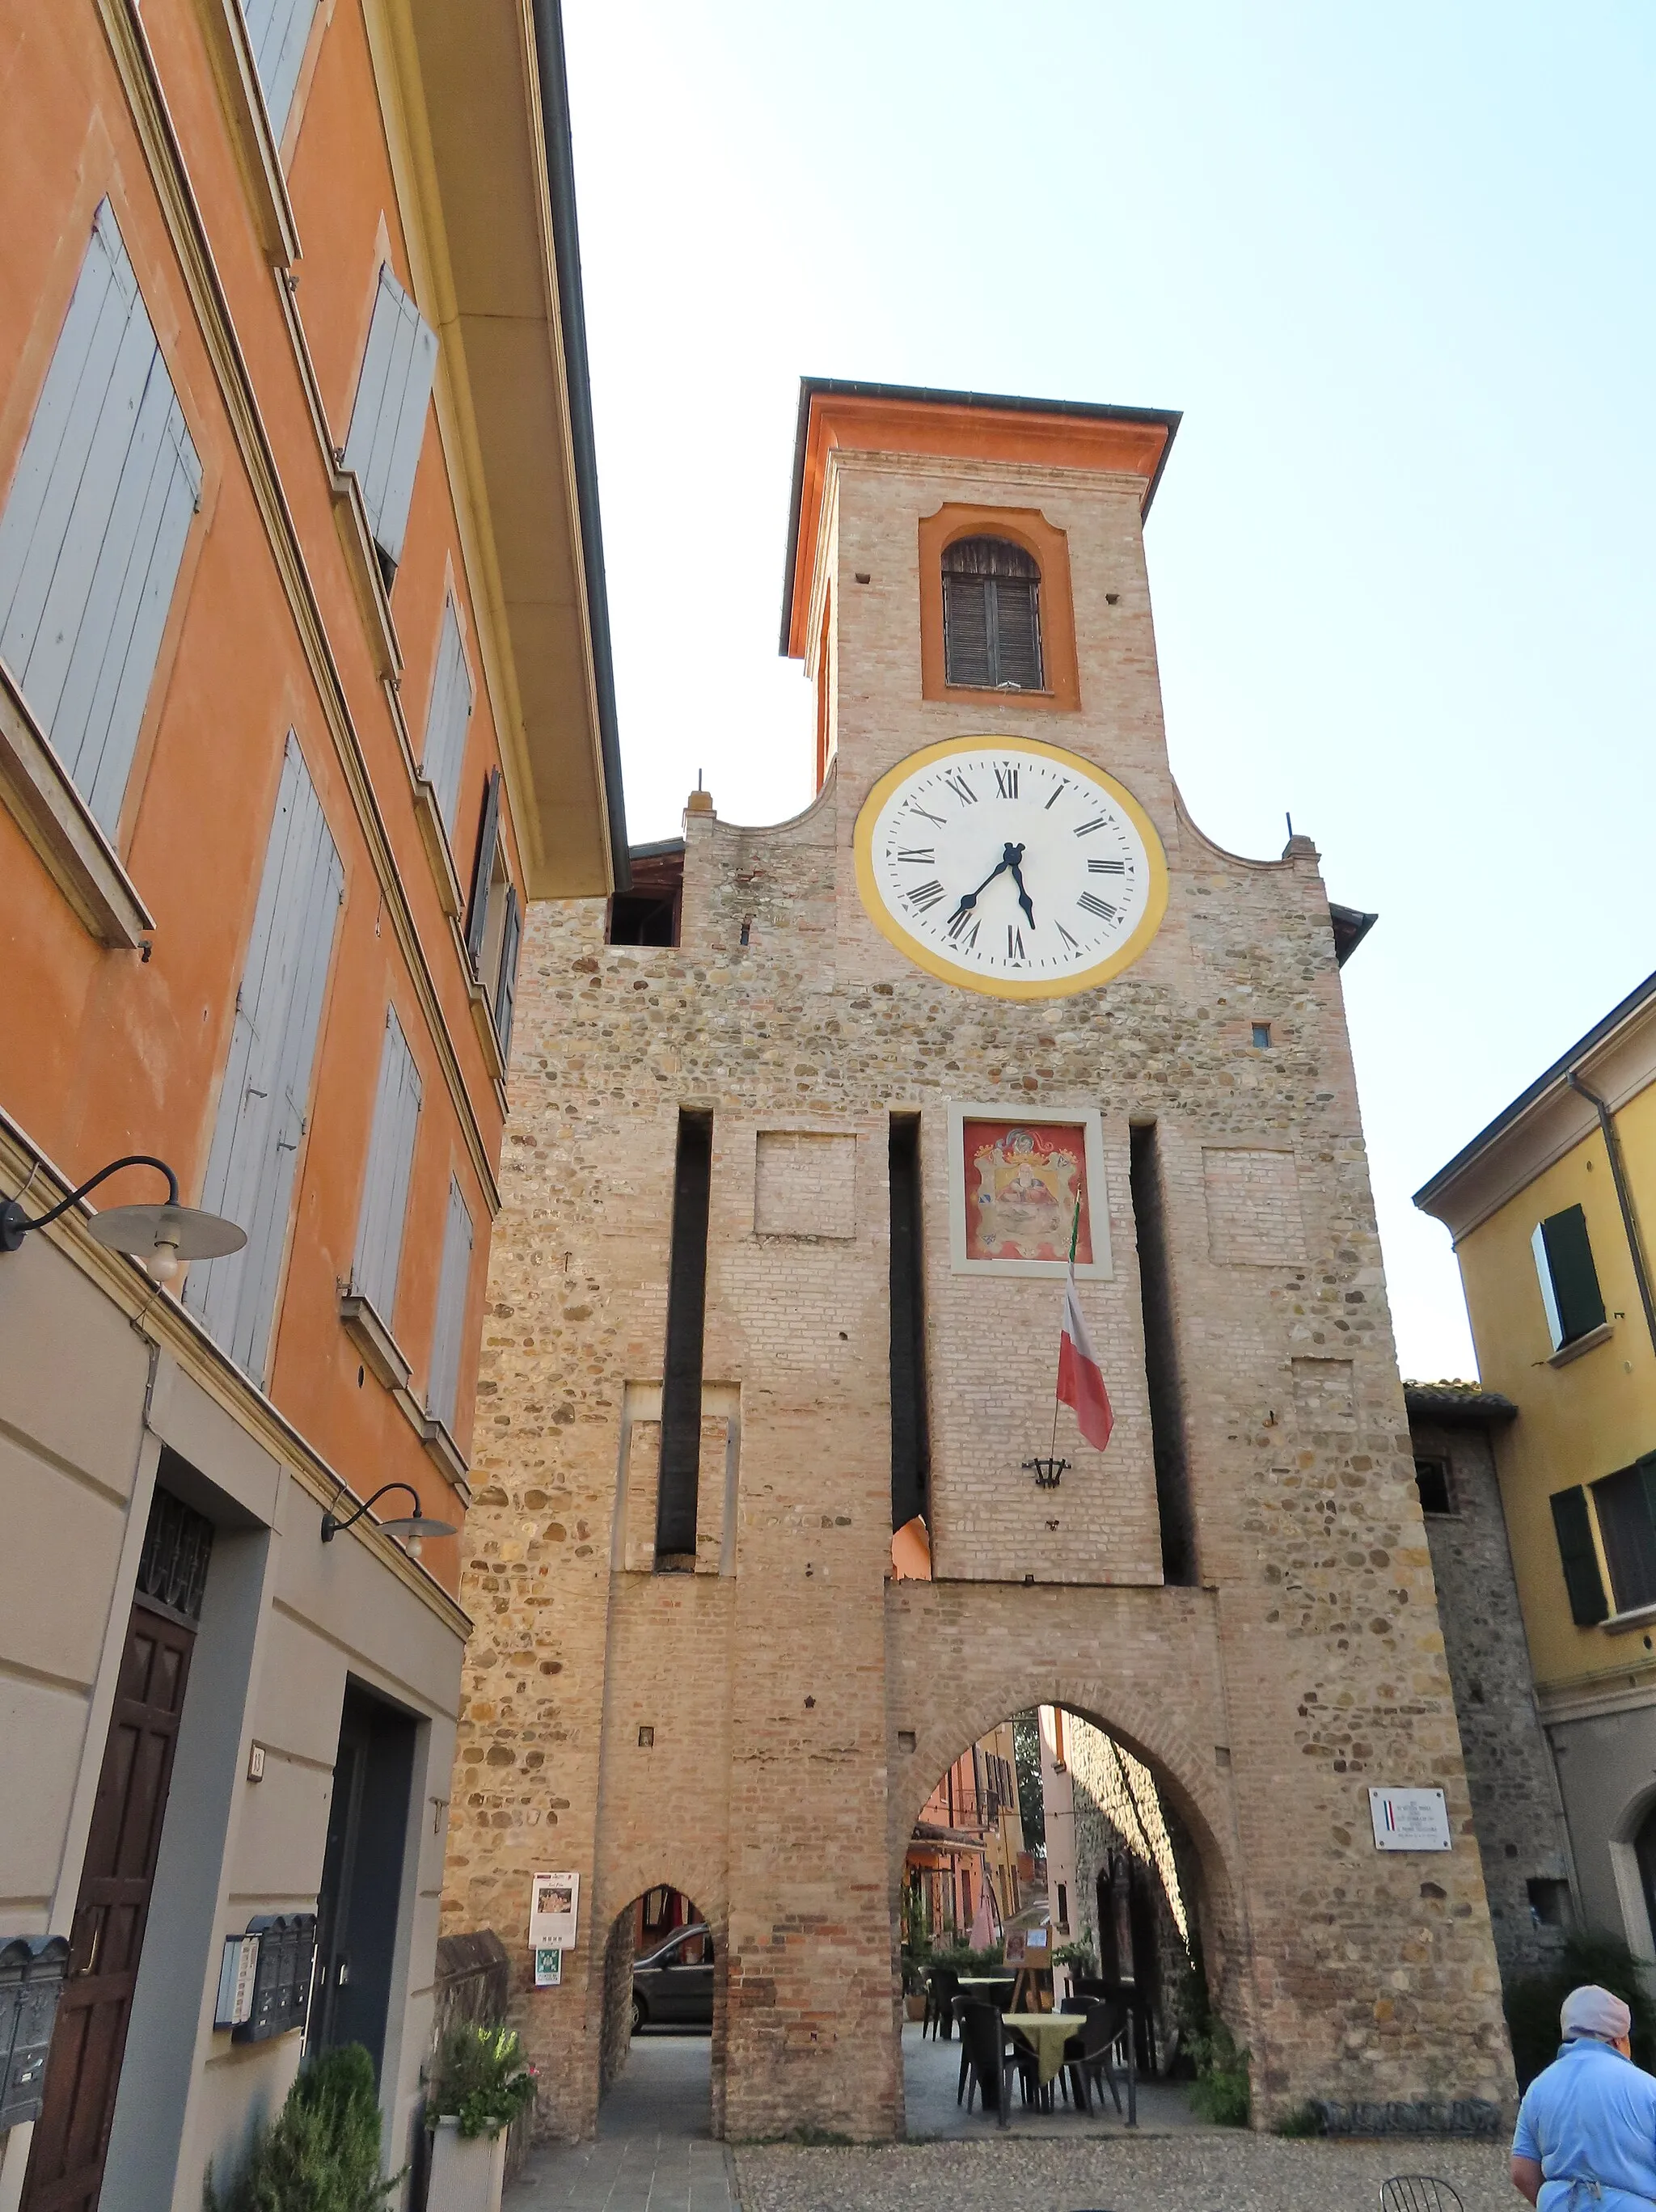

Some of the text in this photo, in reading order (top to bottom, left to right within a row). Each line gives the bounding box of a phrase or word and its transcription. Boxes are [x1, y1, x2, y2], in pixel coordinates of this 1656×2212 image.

[944, 775, 978, 808] XI
[994, 768, 1018, 799] XII
[1044, 785, 1064, 809] I
[910, 803, 947, 830] X
[1073, 817, 1108, 838] II
[898, 846, 936, 863] IX
[1088, 859, 1125, 875] III
[906, 880, 948, 914] VIII
[1076, 890, 1117, 922] IIII
[948, 911, 982, 949] VII
[1008, 924, 1025, 960] VI
[1054, 919, 1079, 951] V
